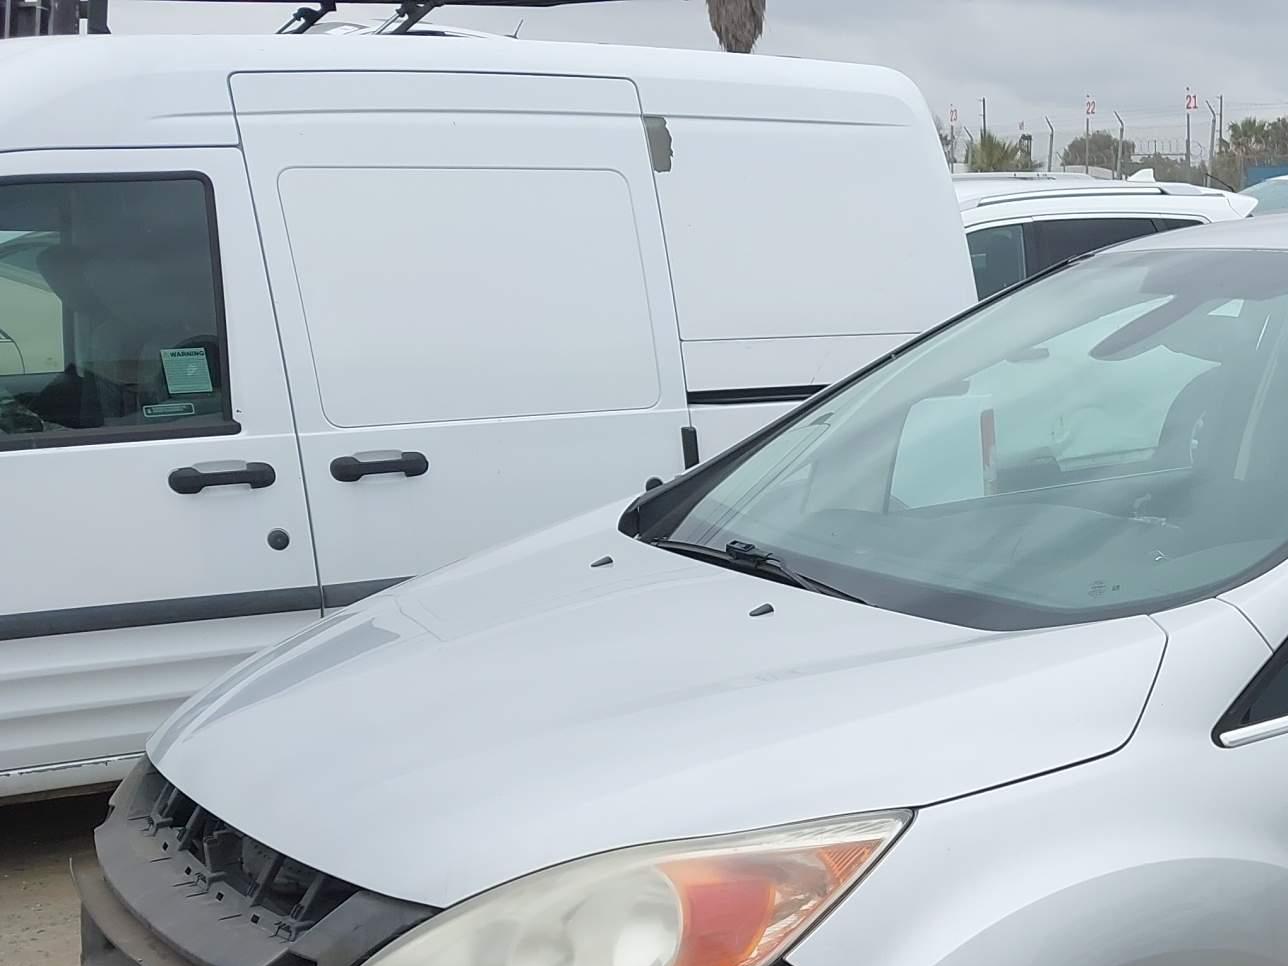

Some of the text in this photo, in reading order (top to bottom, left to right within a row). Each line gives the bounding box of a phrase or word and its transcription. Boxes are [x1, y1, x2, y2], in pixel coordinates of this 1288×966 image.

[1086, 100, 1096, 115] 22
[1185, 94, 1199, 109] 21
[949, 108, 958, 122] 23
[169, 350, 205, 358] WARNING
